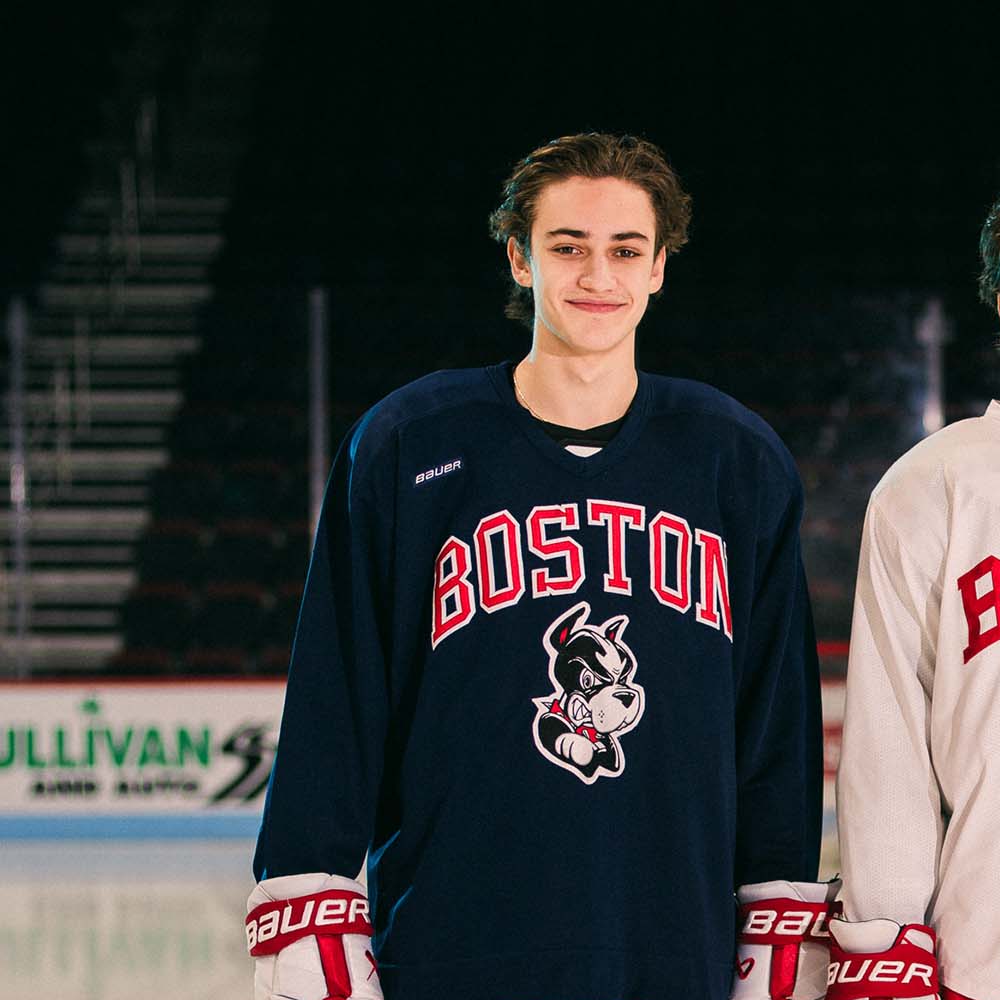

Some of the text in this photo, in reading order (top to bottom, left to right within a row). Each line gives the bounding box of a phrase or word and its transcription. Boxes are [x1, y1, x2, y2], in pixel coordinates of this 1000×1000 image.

[415, 460, 462, 484] BAUER
[431, 498, 734, 652] BOSTON
[245, 898, 371, 951] BAUER
